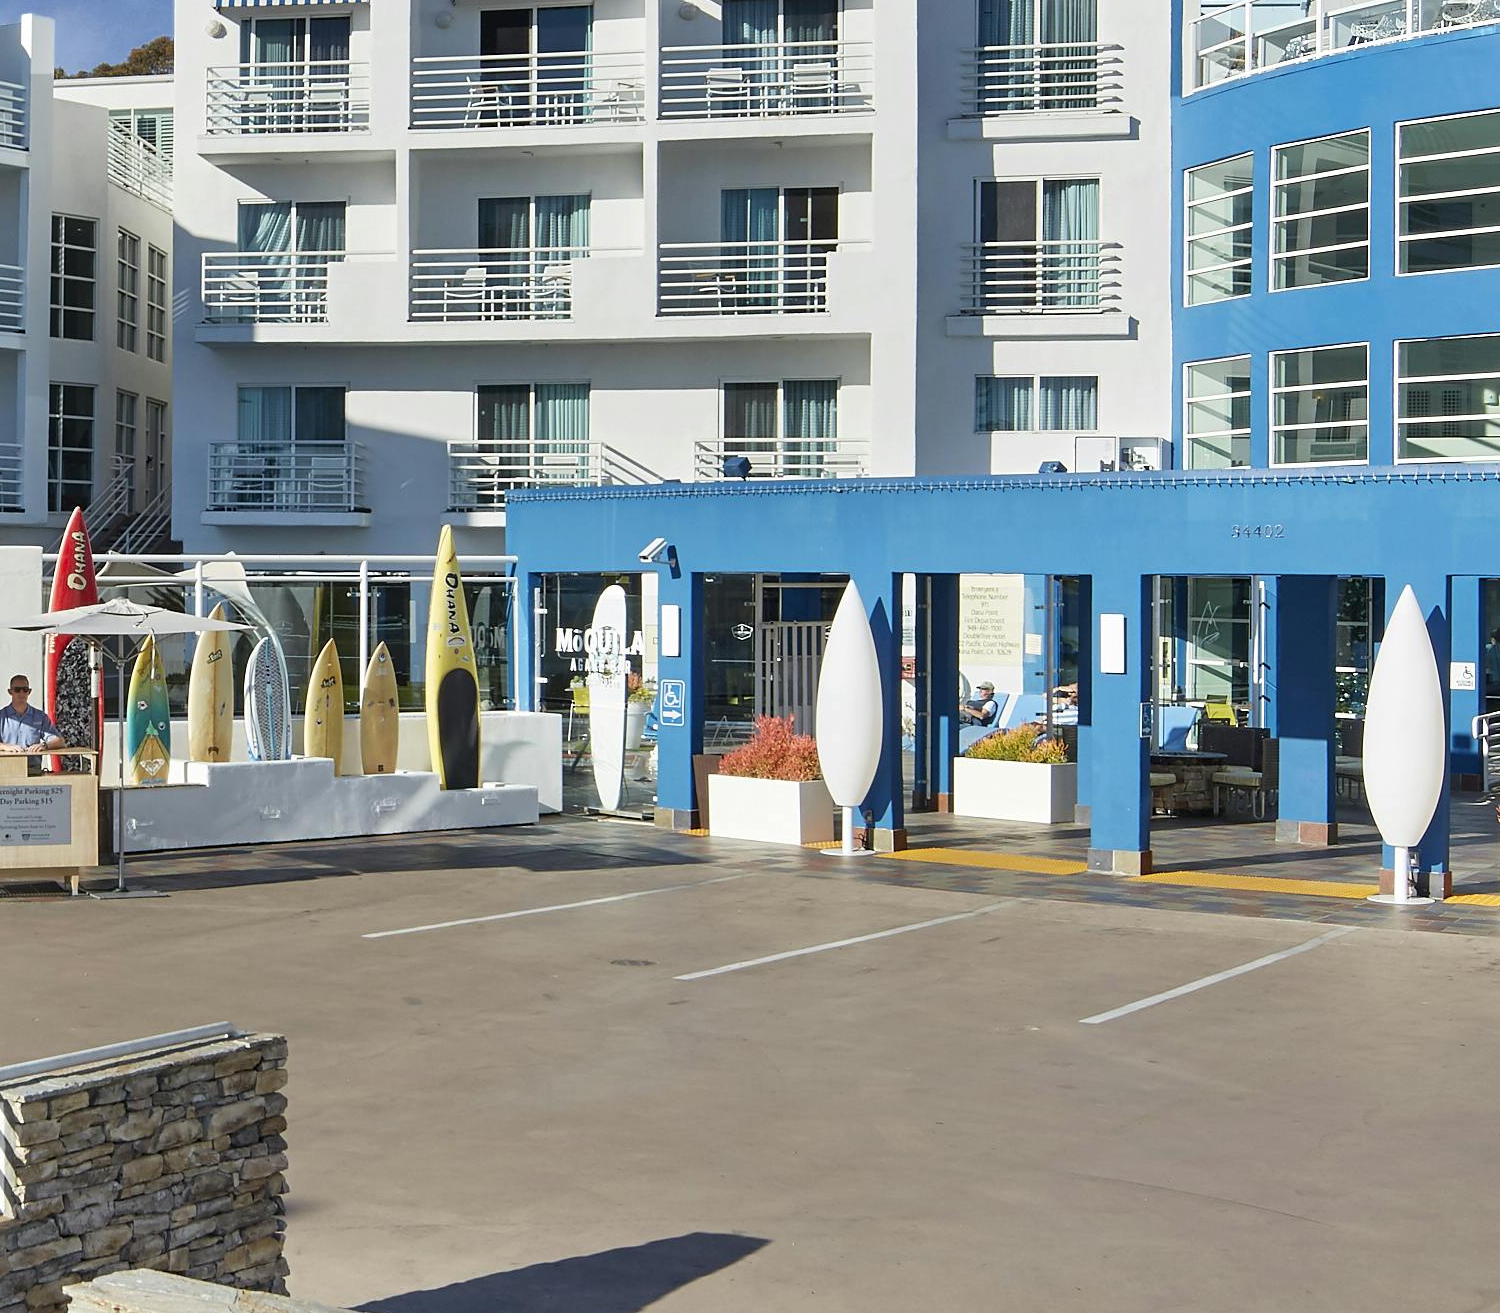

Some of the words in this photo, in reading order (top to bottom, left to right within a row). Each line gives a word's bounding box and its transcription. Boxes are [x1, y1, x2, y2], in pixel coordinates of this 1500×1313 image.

[1232, 525, 1285, 538] 34402
[67, 531, 87, 590] OHANA
[445, 573, 460, 634] OHANA
[14, 797, 39, 805] Parking
[41, 797, 53, 805] $15
